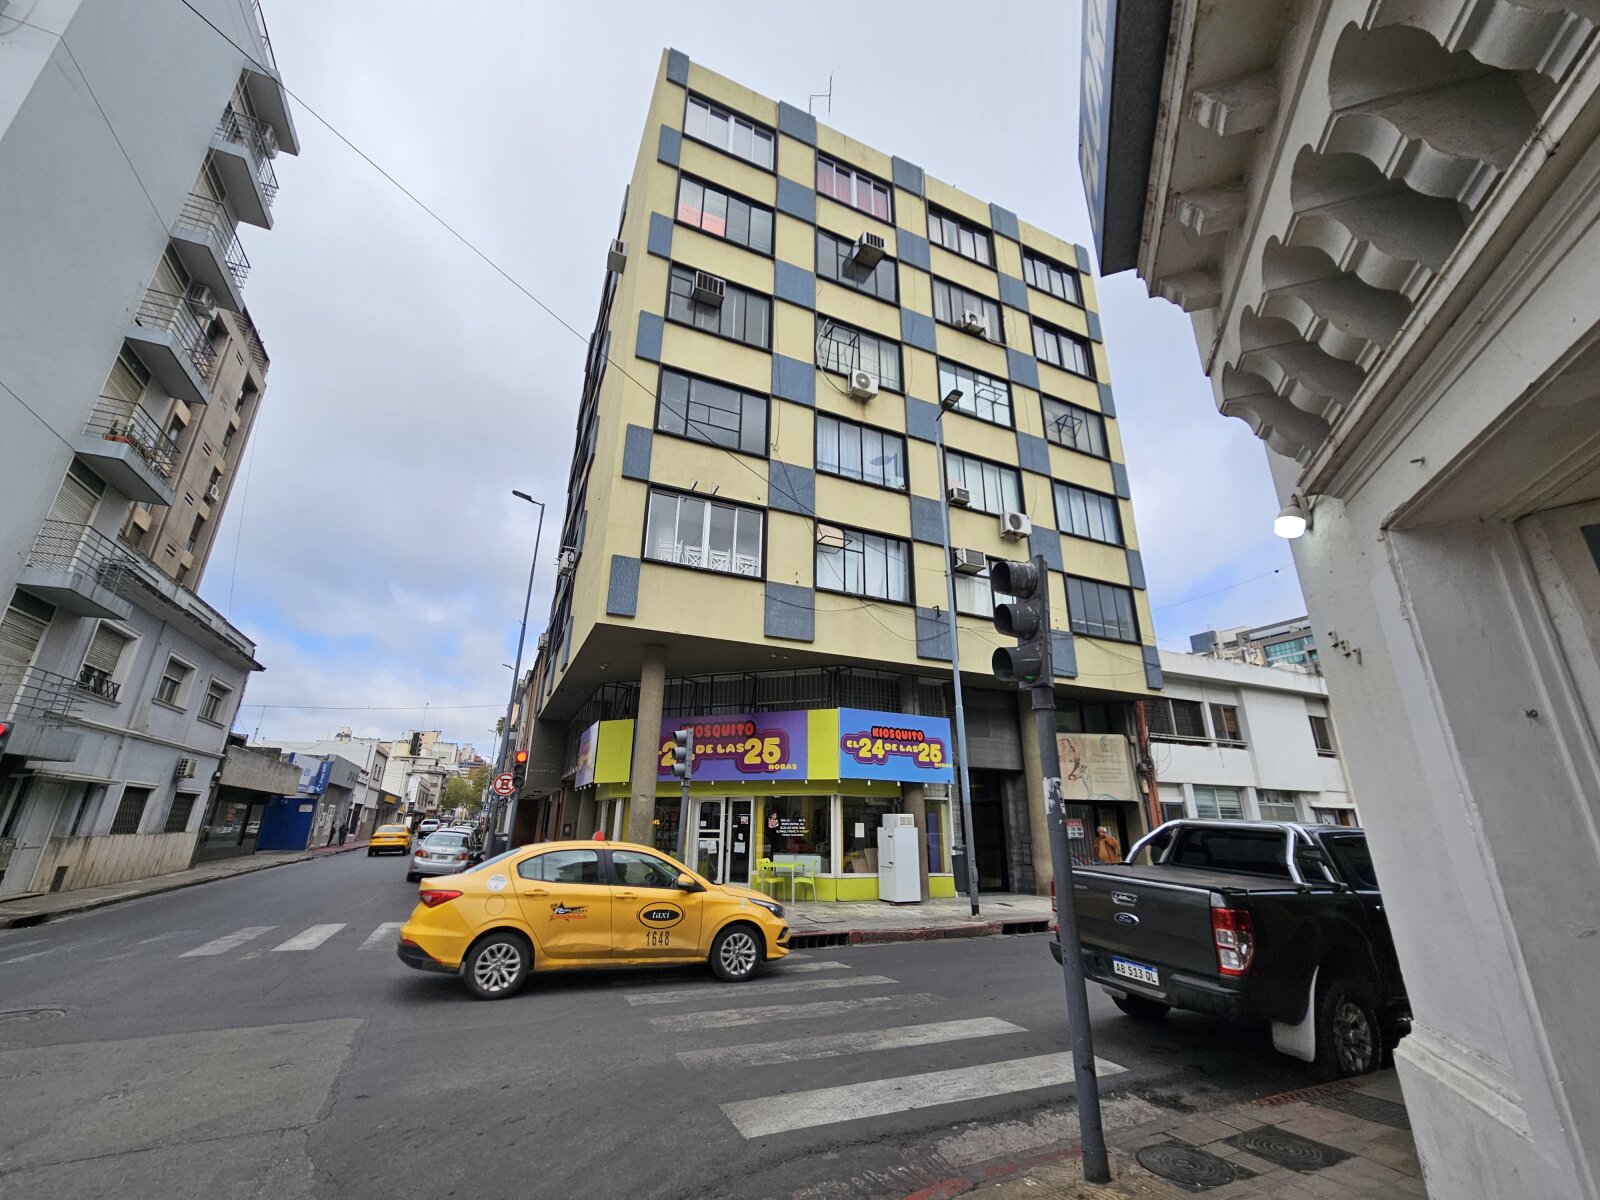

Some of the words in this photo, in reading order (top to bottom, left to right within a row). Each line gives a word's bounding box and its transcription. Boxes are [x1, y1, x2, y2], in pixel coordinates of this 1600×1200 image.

[682, 722, 754, 738] OSQUITO
[872, 727, 924, 741] KIOSQUITO
[696, 744, 713, 754] DE
[717, 743, 744, 754] LAS
[744, 738, 781, 764] 25
[846, 740, 859, 748] EL
[859, 738, 885, 758] 24
[884, 743, 898, 751] DE
[900, 744, 918, 752] LAS
[918, 743, 942, 763] 25
[768, 763, 798, 771] HORAS
[652, 911, 670, 919] taxi
[646, 931, 670, 947] 1648
[1116, 963, 1125, 974] AB
[1128, 967, 1143, 979] 513
[1145, 971, 1157, 983] QL
